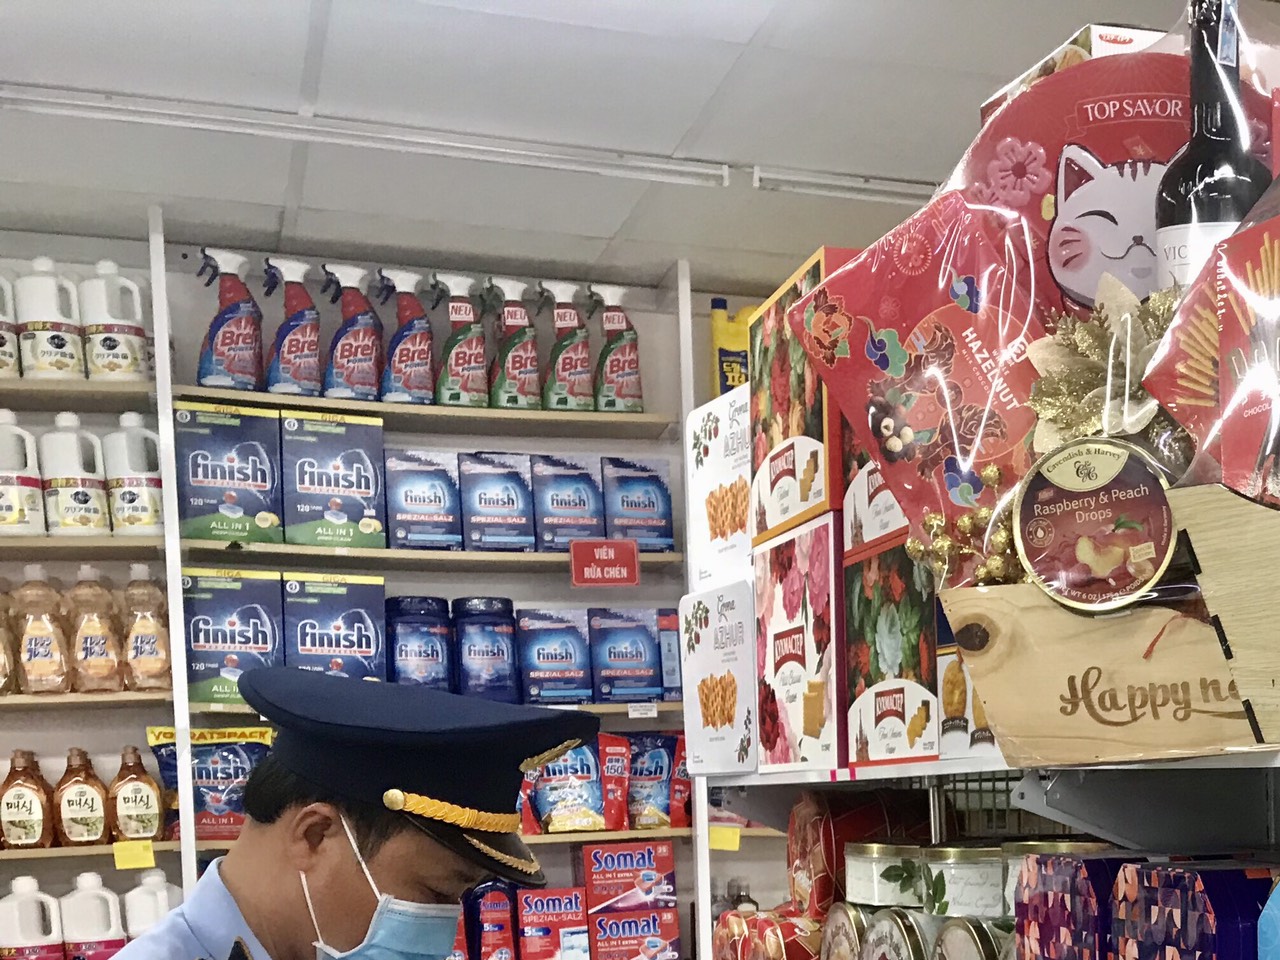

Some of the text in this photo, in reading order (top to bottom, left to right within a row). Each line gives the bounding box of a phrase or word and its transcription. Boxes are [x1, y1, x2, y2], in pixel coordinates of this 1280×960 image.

[1084, 98, 1182, 121] TOP SAVOR
[450, 305, 473, 316] NEU
[507, 309, 528, 320] NEU
[961, 327, 1020, 411] HAZELNUT
[190, 451, 268, 483] finish
[1047, 447, 1122, 474] Cavendish Harvey
[297, 459, 372, 490] finish
[404, 489, 442, 505] finish
[1034, 484, 1150, 517] Raspberry & Peach
[210, 520, 250, 531] ALL IN 1
[1075, 508, 1113, 524] Drops
[315, 526, 333, 535] ALL
[604, 565, 628, 578] CHÉN
[192, 616, 269, 648] finish
[300, 621, 372, 649] finish
[1060, 666, 1240, 727] Happy ne
[151, 730, 268, 742] VORATSPACK
[591, 848, 655, 871] Somat
[522, 893, 582, 915] Somat
[595, 914, 661, 940] Somat
